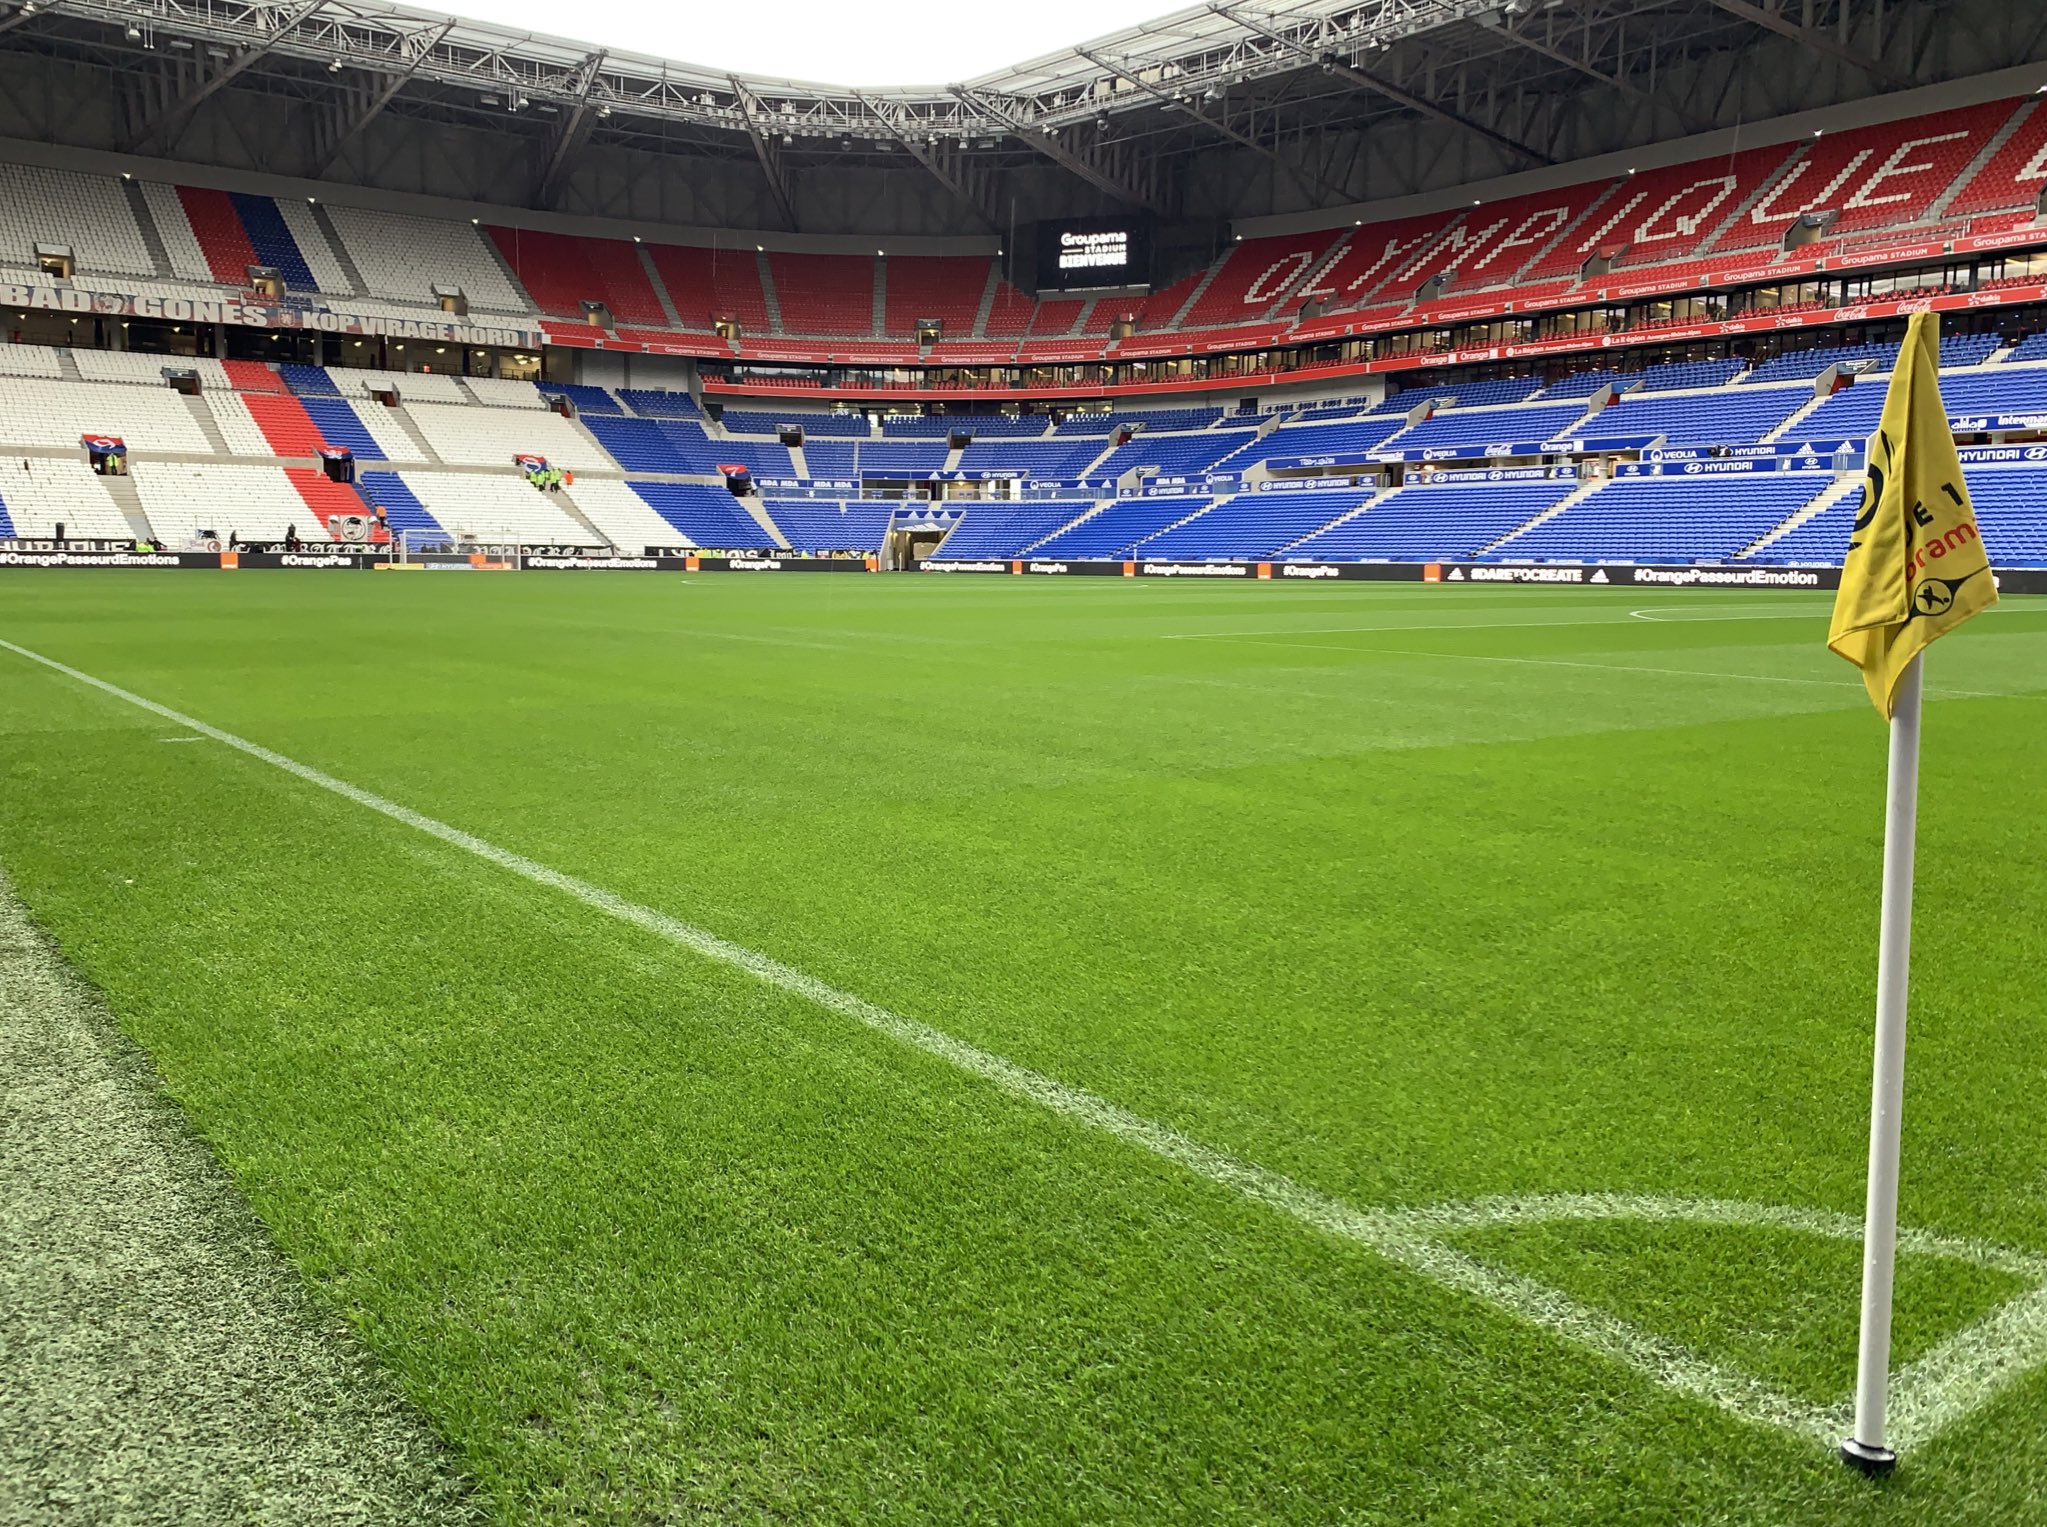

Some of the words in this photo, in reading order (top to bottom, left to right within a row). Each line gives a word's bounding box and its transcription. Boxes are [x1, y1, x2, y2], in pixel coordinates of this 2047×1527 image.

[1244, 131, 1969, 303] OLYMPIQUE
[1061, 232, 1127, 247] Groupama
[1973, 233, 2026, 248] Groupama
[1084, 244, 1127, 255] STADIUM
[1059, 252, 1127, 268] BIENVENUE
[1841, 253, 1888, 266] Groupama
[1890, 248, 1928, 259] STADIUM
[1723, 270, 1766, 282] Groupama
[1767, 265, 1801, 276] STADIUM
[1618, 285, 1657, 297] Groupama
[1658, 281, 1688, 291] STADIUM
[2, 284, 91, 313] BAD
[135, 296, 268, 327] GONES
[1524, 298, 1558, 309] Groupama
[1559, 295, 1587, 304] STADIUM
[302, 311, 353, 333] KOP
[357, 316, 450, 340] VIRAGE
[454, 326, 519, 347] NORD
[1420, 355, 1448, 366] Orange
[1460, 351, 1489, 361] Orange
[1540, 442, 1573, 453] Orange
[1664, 450, 1697, 459] VEOLIA
[1734, 446, 1775, 456] HYUNDAI
[1959, 449, 2020, 461] HYUNDAI
[1704, 461, 1753, 472] HYUNDAI
[1449, 472, 1486, 481] HYUNDAI
[1505, 470, 1544, 479] HYUNDAI
[1905, 517, 1980, 582] oram
[0, 552, 180, 566] #OrangePasseurdEmotions
[281, 555, 351, 567] #OrangePas
[729, 559, 781, 570] #OrangePas
[1471, 568, 1582, 581] #DARETOCREATE
[1634, 569, 1818, 585] #OrangePasseurdEmotion
